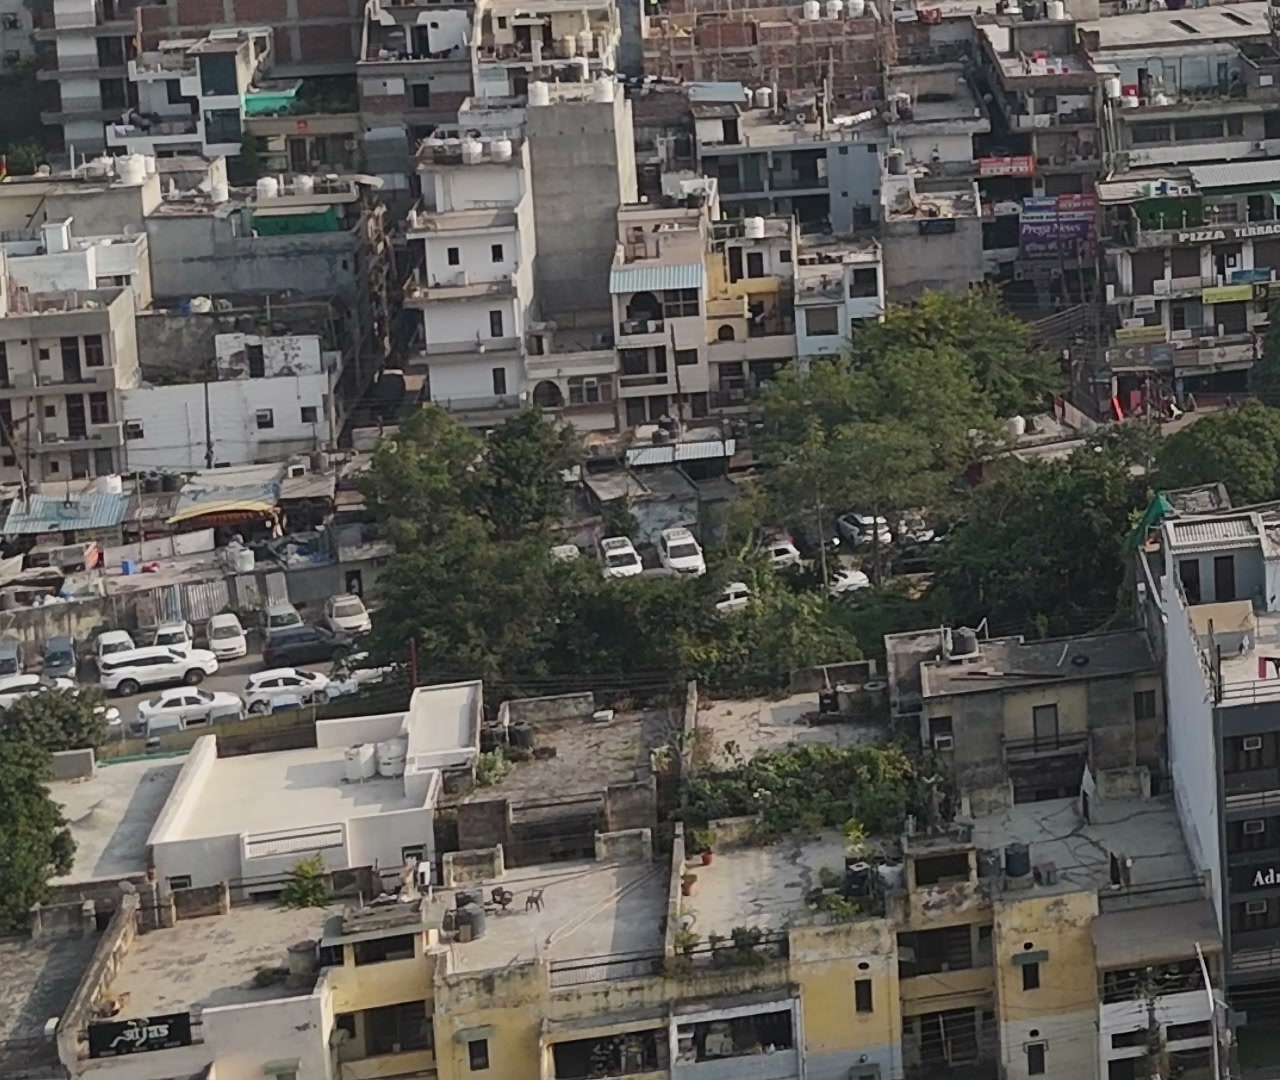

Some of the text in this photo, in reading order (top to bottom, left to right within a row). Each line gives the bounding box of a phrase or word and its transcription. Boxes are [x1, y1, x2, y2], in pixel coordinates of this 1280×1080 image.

[1022, 224, 1050, 236] Prega
[1052, 223, 1081, 233] News
[1179, 230, 1226, 243] PIZZA
